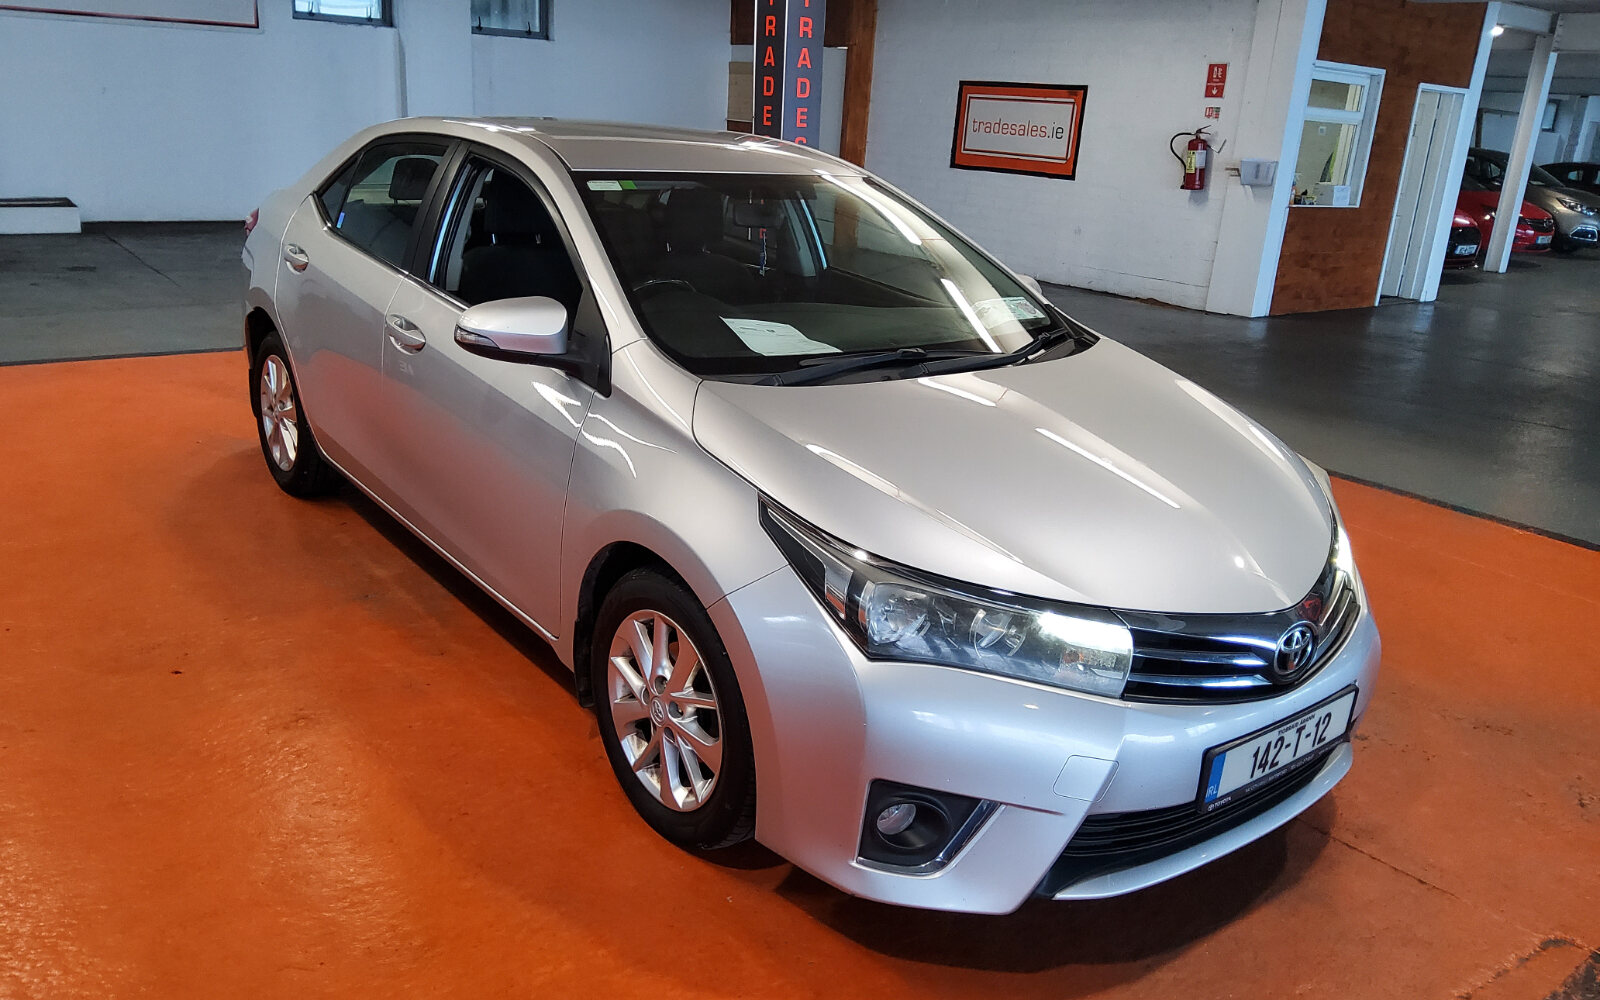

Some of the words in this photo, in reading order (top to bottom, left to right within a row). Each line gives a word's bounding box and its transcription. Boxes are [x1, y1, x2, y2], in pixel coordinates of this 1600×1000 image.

[972, 118, 1064, 140] tradesales.ie
[1250, 711, 1332, 779] 142-T-12
[1205, 784, 1218, 798] IRL
